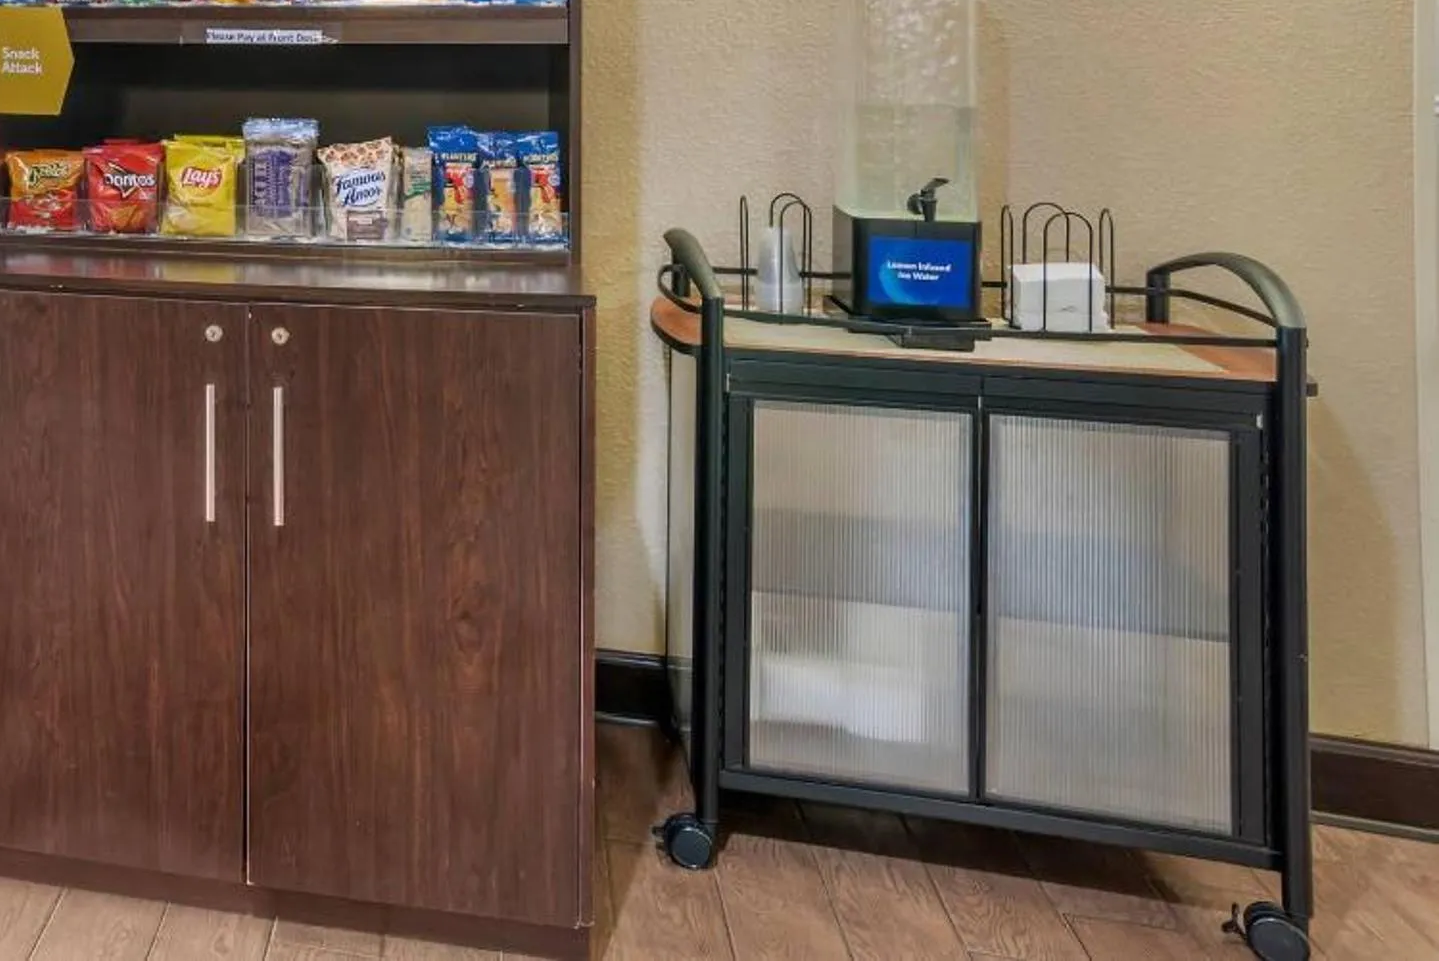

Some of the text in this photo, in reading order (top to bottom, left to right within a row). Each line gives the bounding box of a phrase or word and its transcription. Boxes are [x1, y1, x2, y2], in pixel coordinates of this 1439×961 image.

[1, 46, 40, 60] Snack
[0, 61, 43, 75] Attack
[104, 172, 157, 188] Doritos
[183, 167, 222, 188] Lay's
[335, 169, 386, 194] Famous
[343, 185, 382, 206] Amos
[887, 260, 951, 272] Lemon Infused
[913, 271, 939, 281] Water
